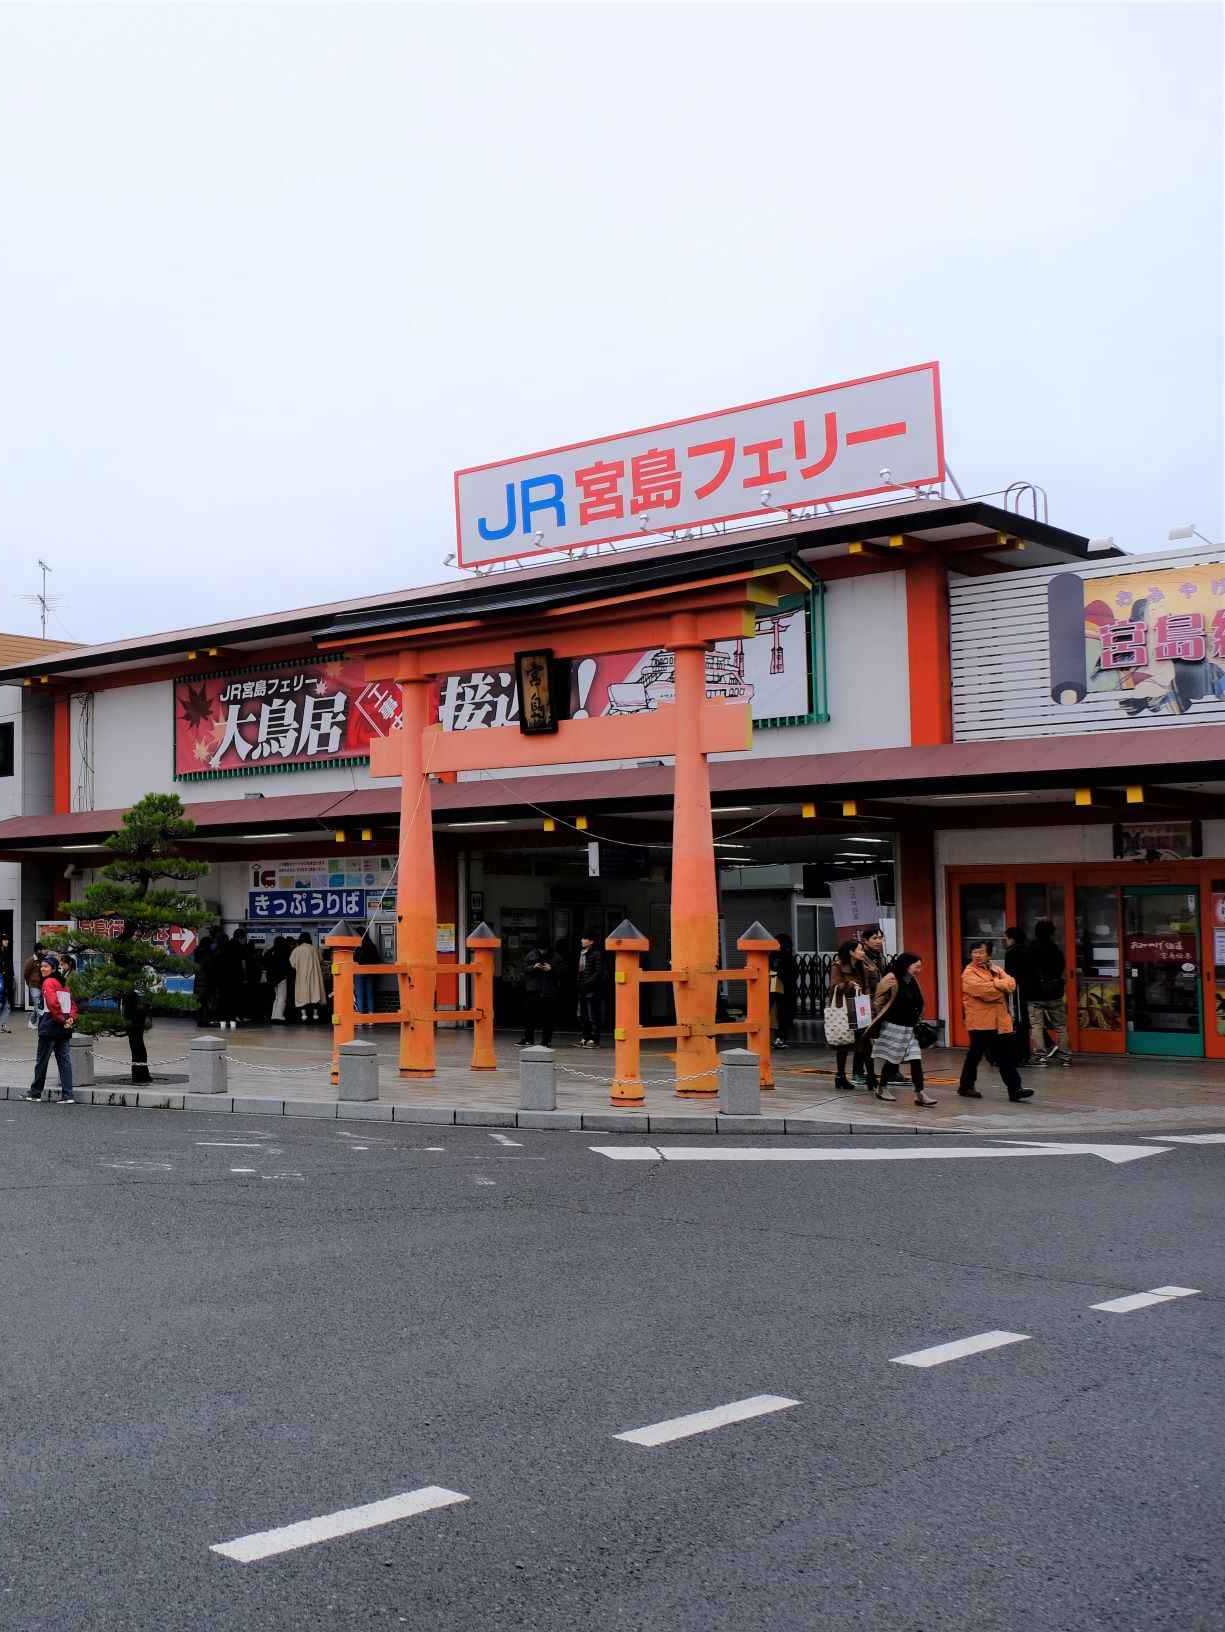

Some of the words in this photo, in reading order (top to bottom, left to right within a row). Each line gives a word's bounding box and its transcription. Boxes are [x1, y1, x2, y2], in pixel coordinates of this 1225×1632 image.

[477, 412, 907, 541] JR宮島フェリー
[220, 675, 318, 702] JR宮島フェリー
[213, 690, 348, 763] 大鳥居
[254, 891, 360, 915] きっぷうりば
